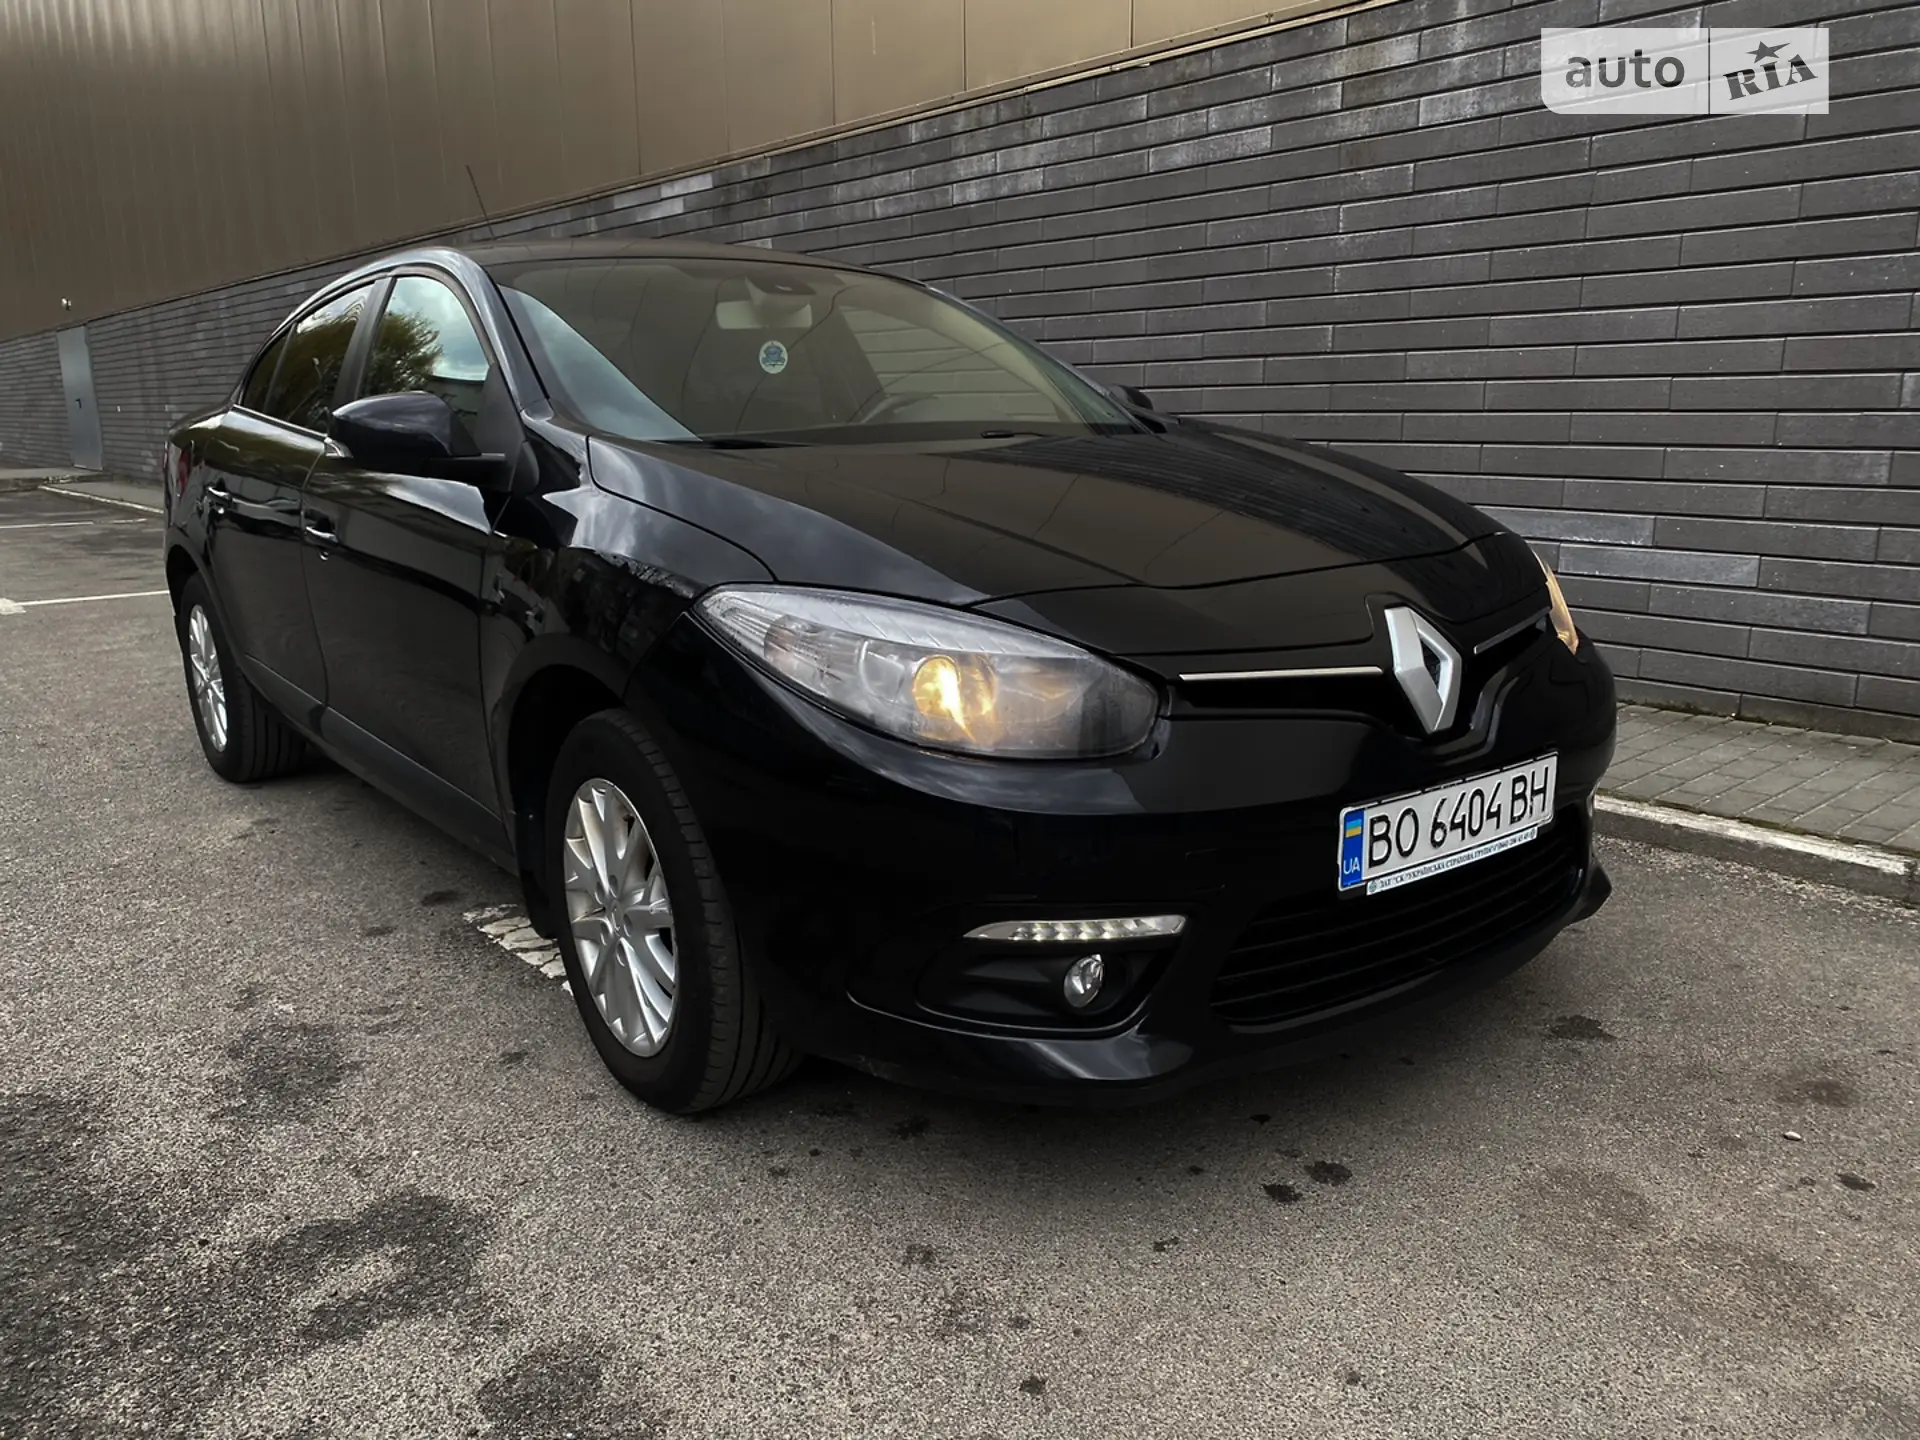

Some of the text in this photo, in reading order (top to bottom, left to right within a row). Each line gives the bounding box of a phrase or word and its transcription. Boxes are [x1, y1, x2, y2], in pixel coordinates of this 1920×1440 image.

[1368, 766, 1549, 868] BO 6404 BH
[1343, 857, 1361, 875] UA
